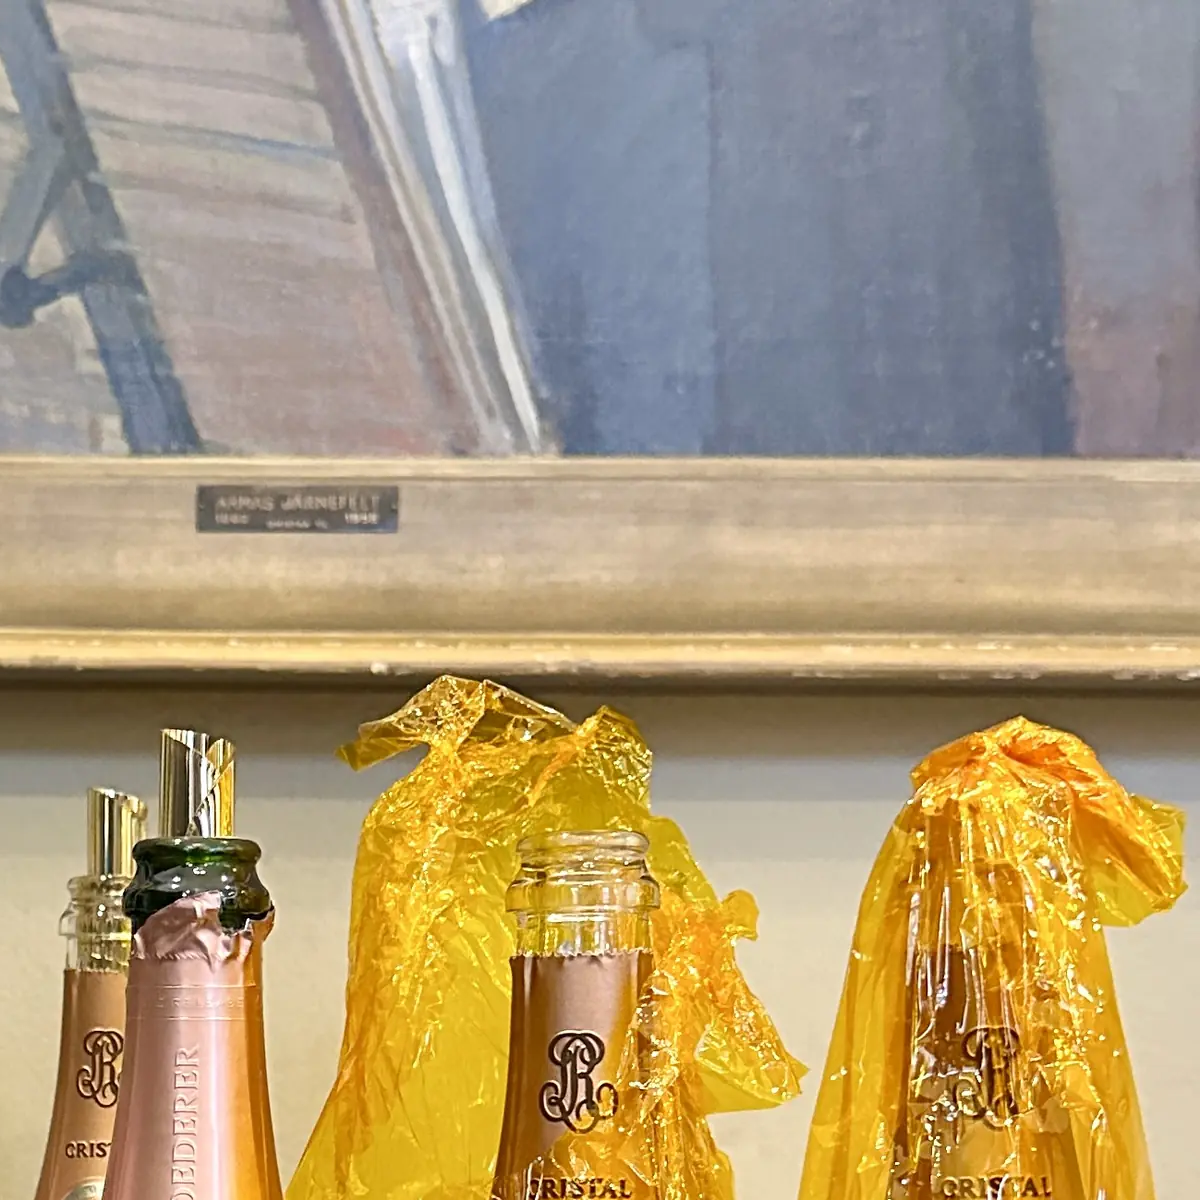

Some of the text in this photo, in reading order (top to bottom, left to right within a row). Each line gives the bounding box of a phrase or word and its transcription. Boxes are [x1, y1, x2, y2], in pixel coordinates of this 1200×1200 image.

[65, 1140, 113, 1159] CRIS
[530, 1177, 633, 1200] CRISTAL
[941, 1176, 1052, 1199] CRISTAL
